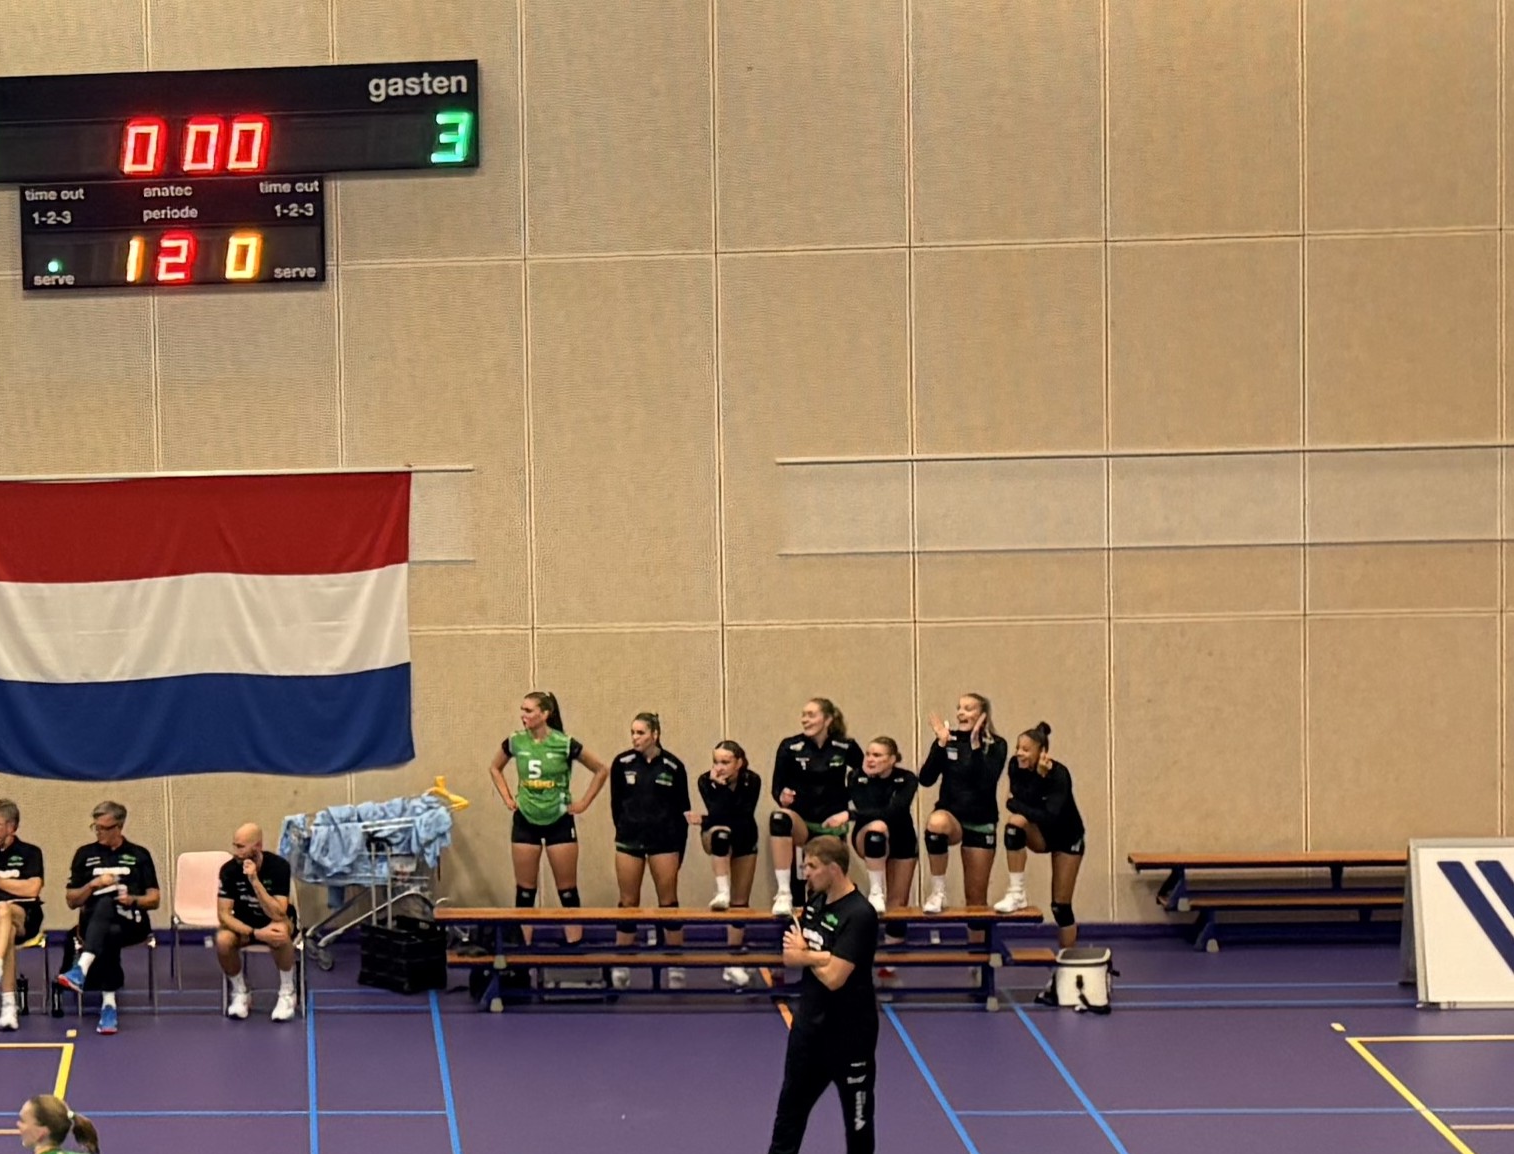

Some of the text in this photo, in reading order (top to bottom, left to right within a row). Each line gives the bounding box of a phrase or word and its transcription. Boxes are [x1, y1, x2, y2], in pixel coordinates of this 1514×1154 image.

[368, 72, 468, 102] gasten
[122, 120, 163, 175] 0
[430, 111, 470, 163] 3
[143, 185, 193, 198] anatec
[259, 179, 320, 194] time out
[25, 188, 85, 201] time out
[143, 206, 198, 222] periode
[274, 203, 314, 217] 1-2-3
[32, 211, 72, 225] 1-2-3
[156, 236, 191, 283] 2
[33, 273, 75, 286] serve
[273, 266, 316, 279] serve
[528, 760, 542, 779] 5
